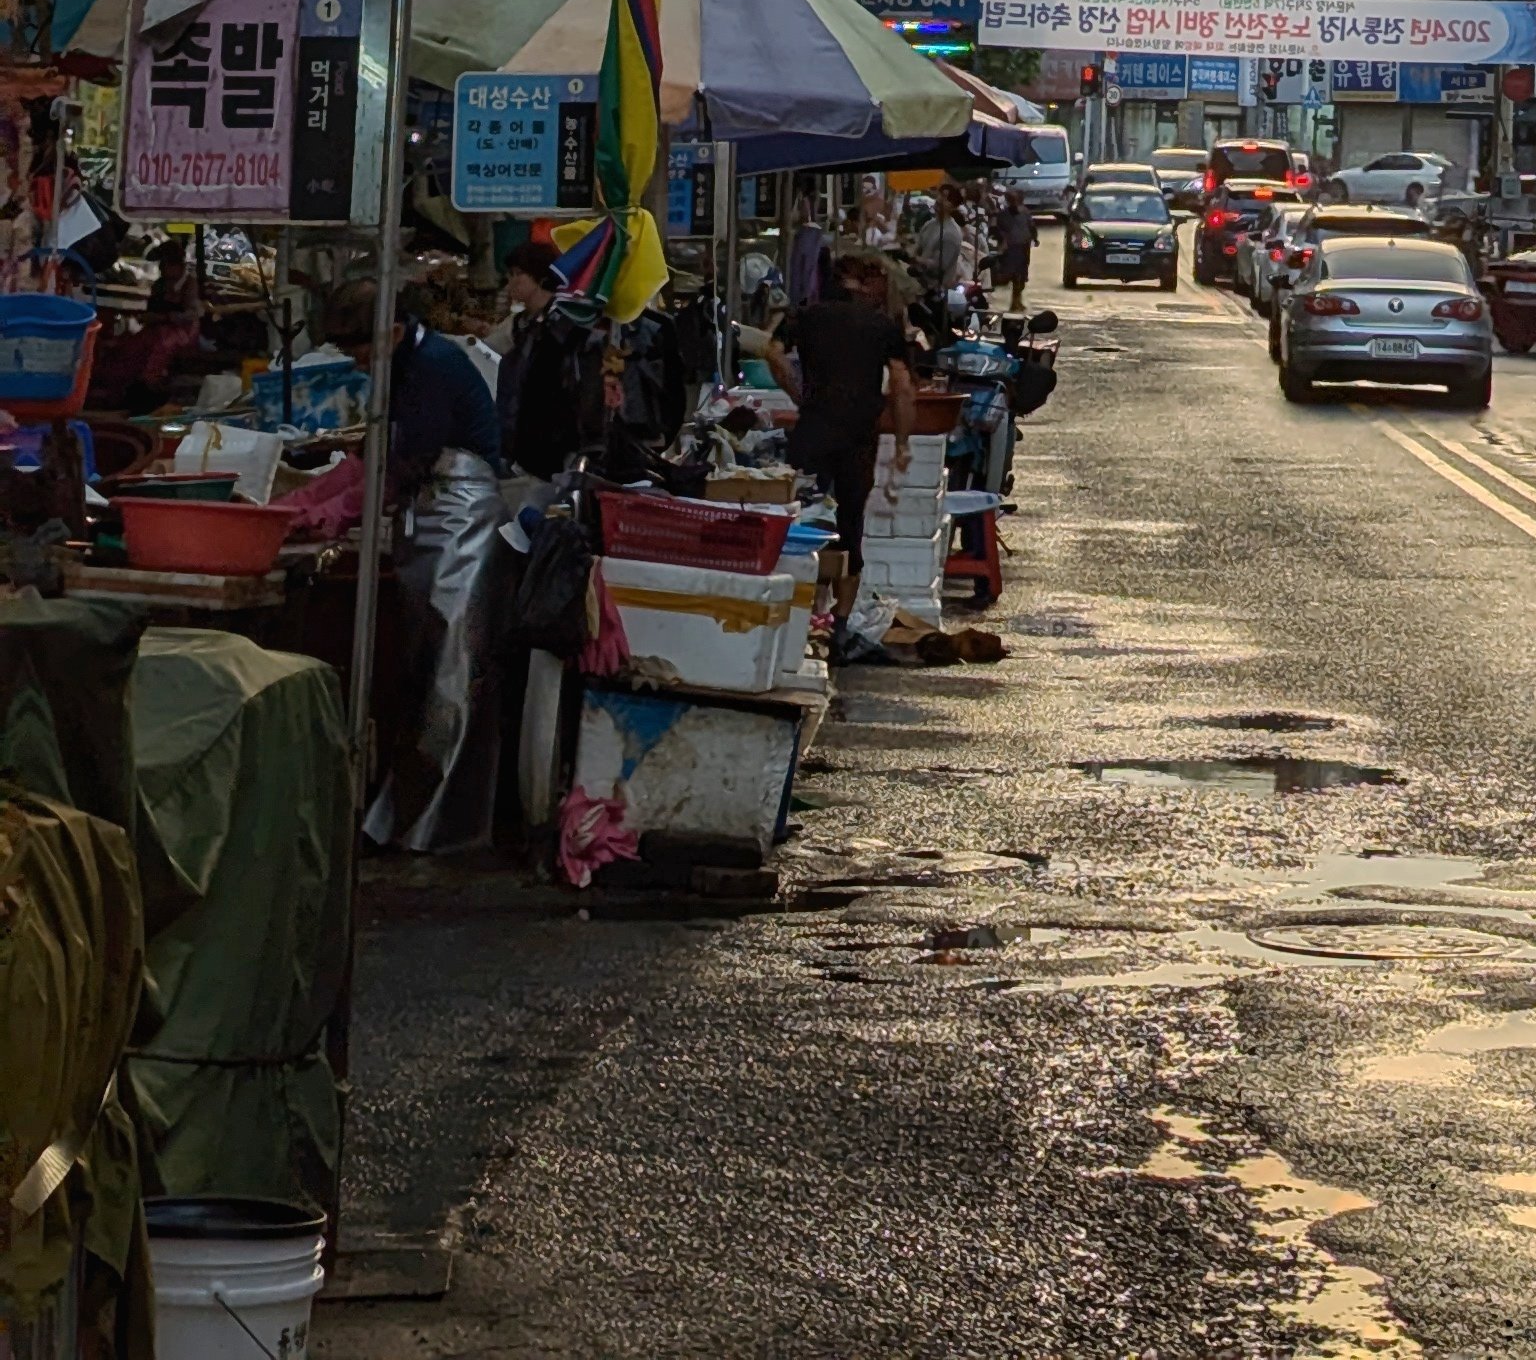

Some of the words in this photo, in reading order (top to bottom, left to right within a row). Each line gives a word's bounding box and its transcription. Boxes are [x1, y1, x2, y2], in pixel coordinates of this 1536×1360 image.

[151, 22, 284, 129] 족발
[1334, 60, 1397, 89] 유림당
[307, 59, 331, 132] 먹거리
[468, 85, 552, 111] 대성수산
[138, 153, 281, 186] 010-7677-8104
